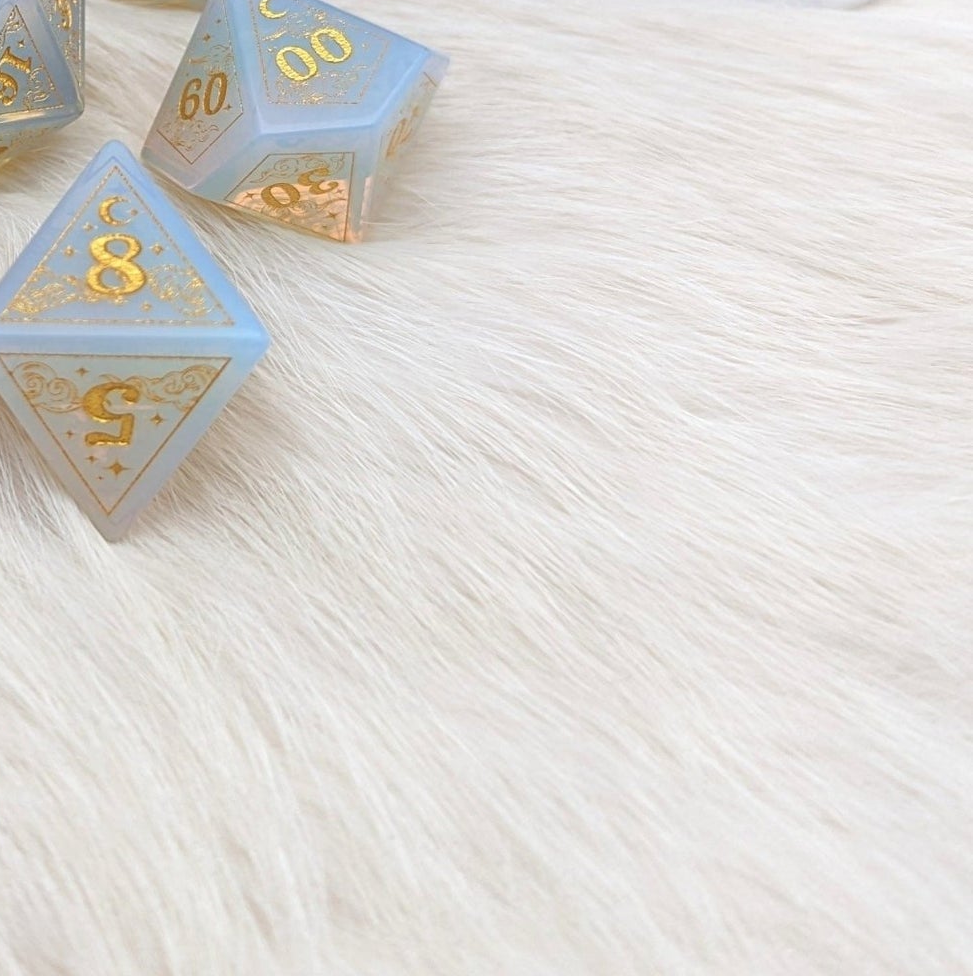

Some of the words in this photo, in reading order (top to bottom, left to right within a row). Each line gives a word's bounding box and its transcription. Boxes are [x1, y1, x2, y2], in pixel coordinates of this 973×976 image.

[275, 27, 353, 82] 00
[178, 72, 228, 121] 60
[260, 167, 340, 208] 30
[85, 233, 148, 296] 8
[82, 381, 141, 446] 5
